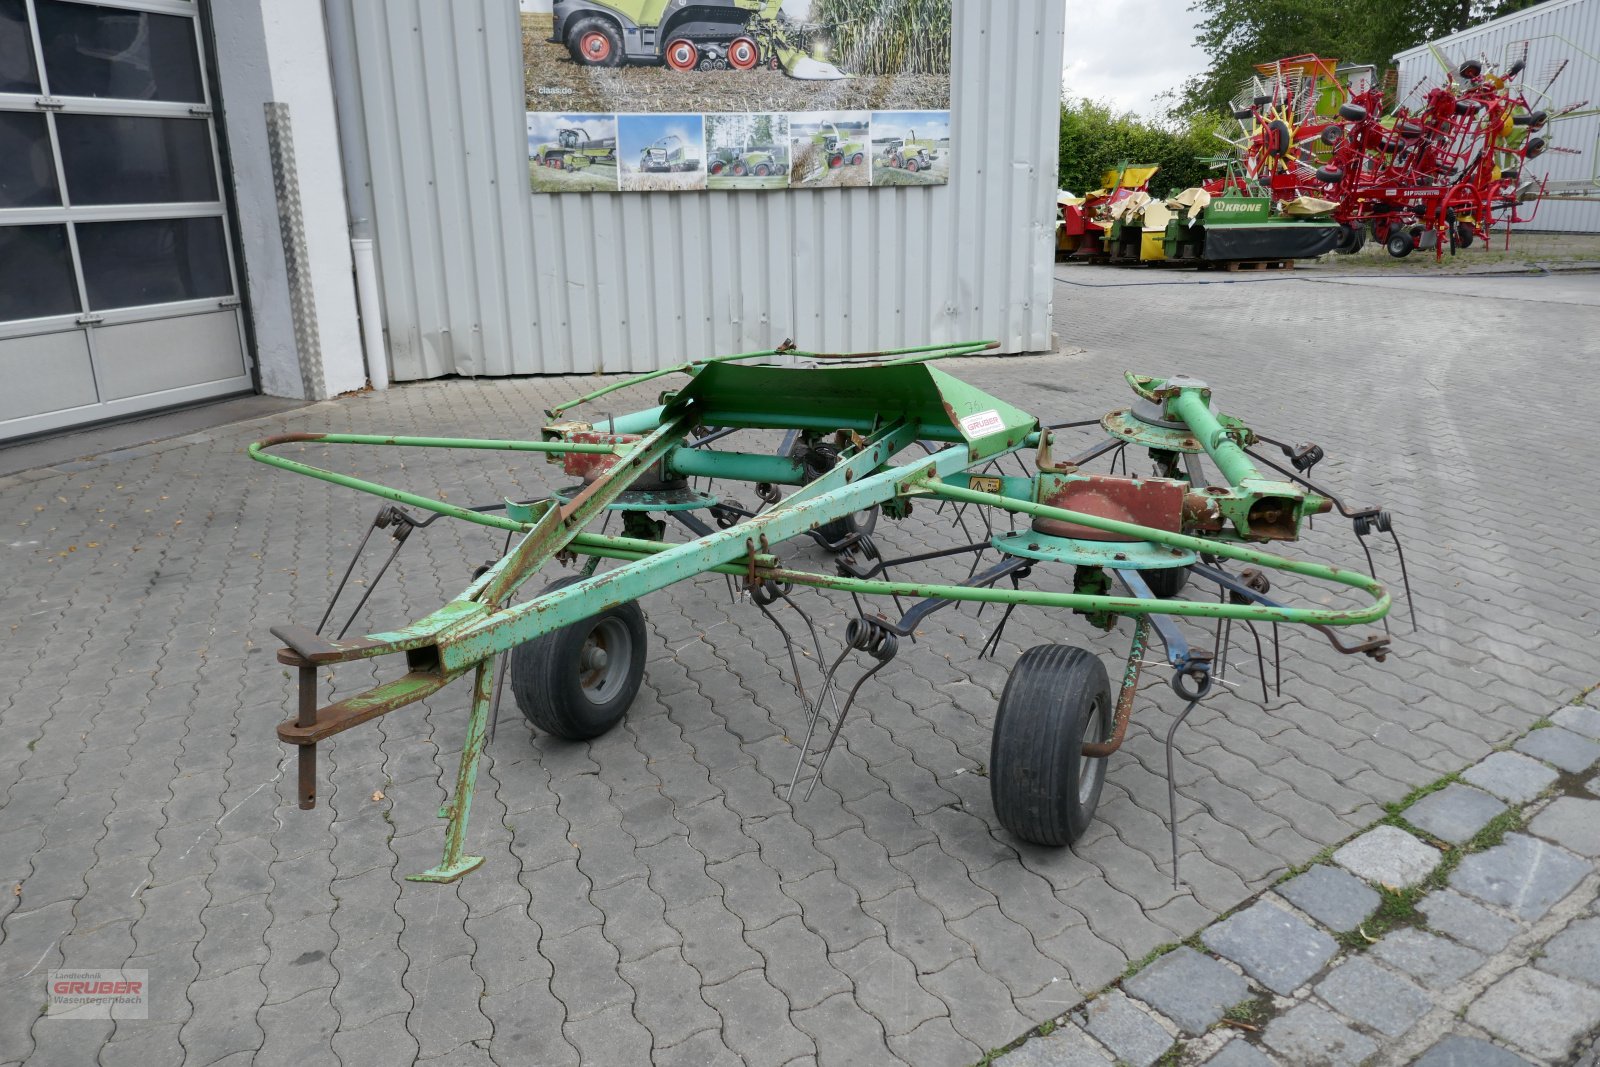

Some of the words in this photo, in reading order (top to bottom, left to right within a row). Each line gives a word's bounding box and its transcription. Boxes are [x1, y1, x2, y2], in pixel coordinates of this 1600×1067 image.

[538, 86, 573, 95] claas.de
[1224, 203, 1262, 212] KRONE
[967, 416, 999, 431] GRUBER
